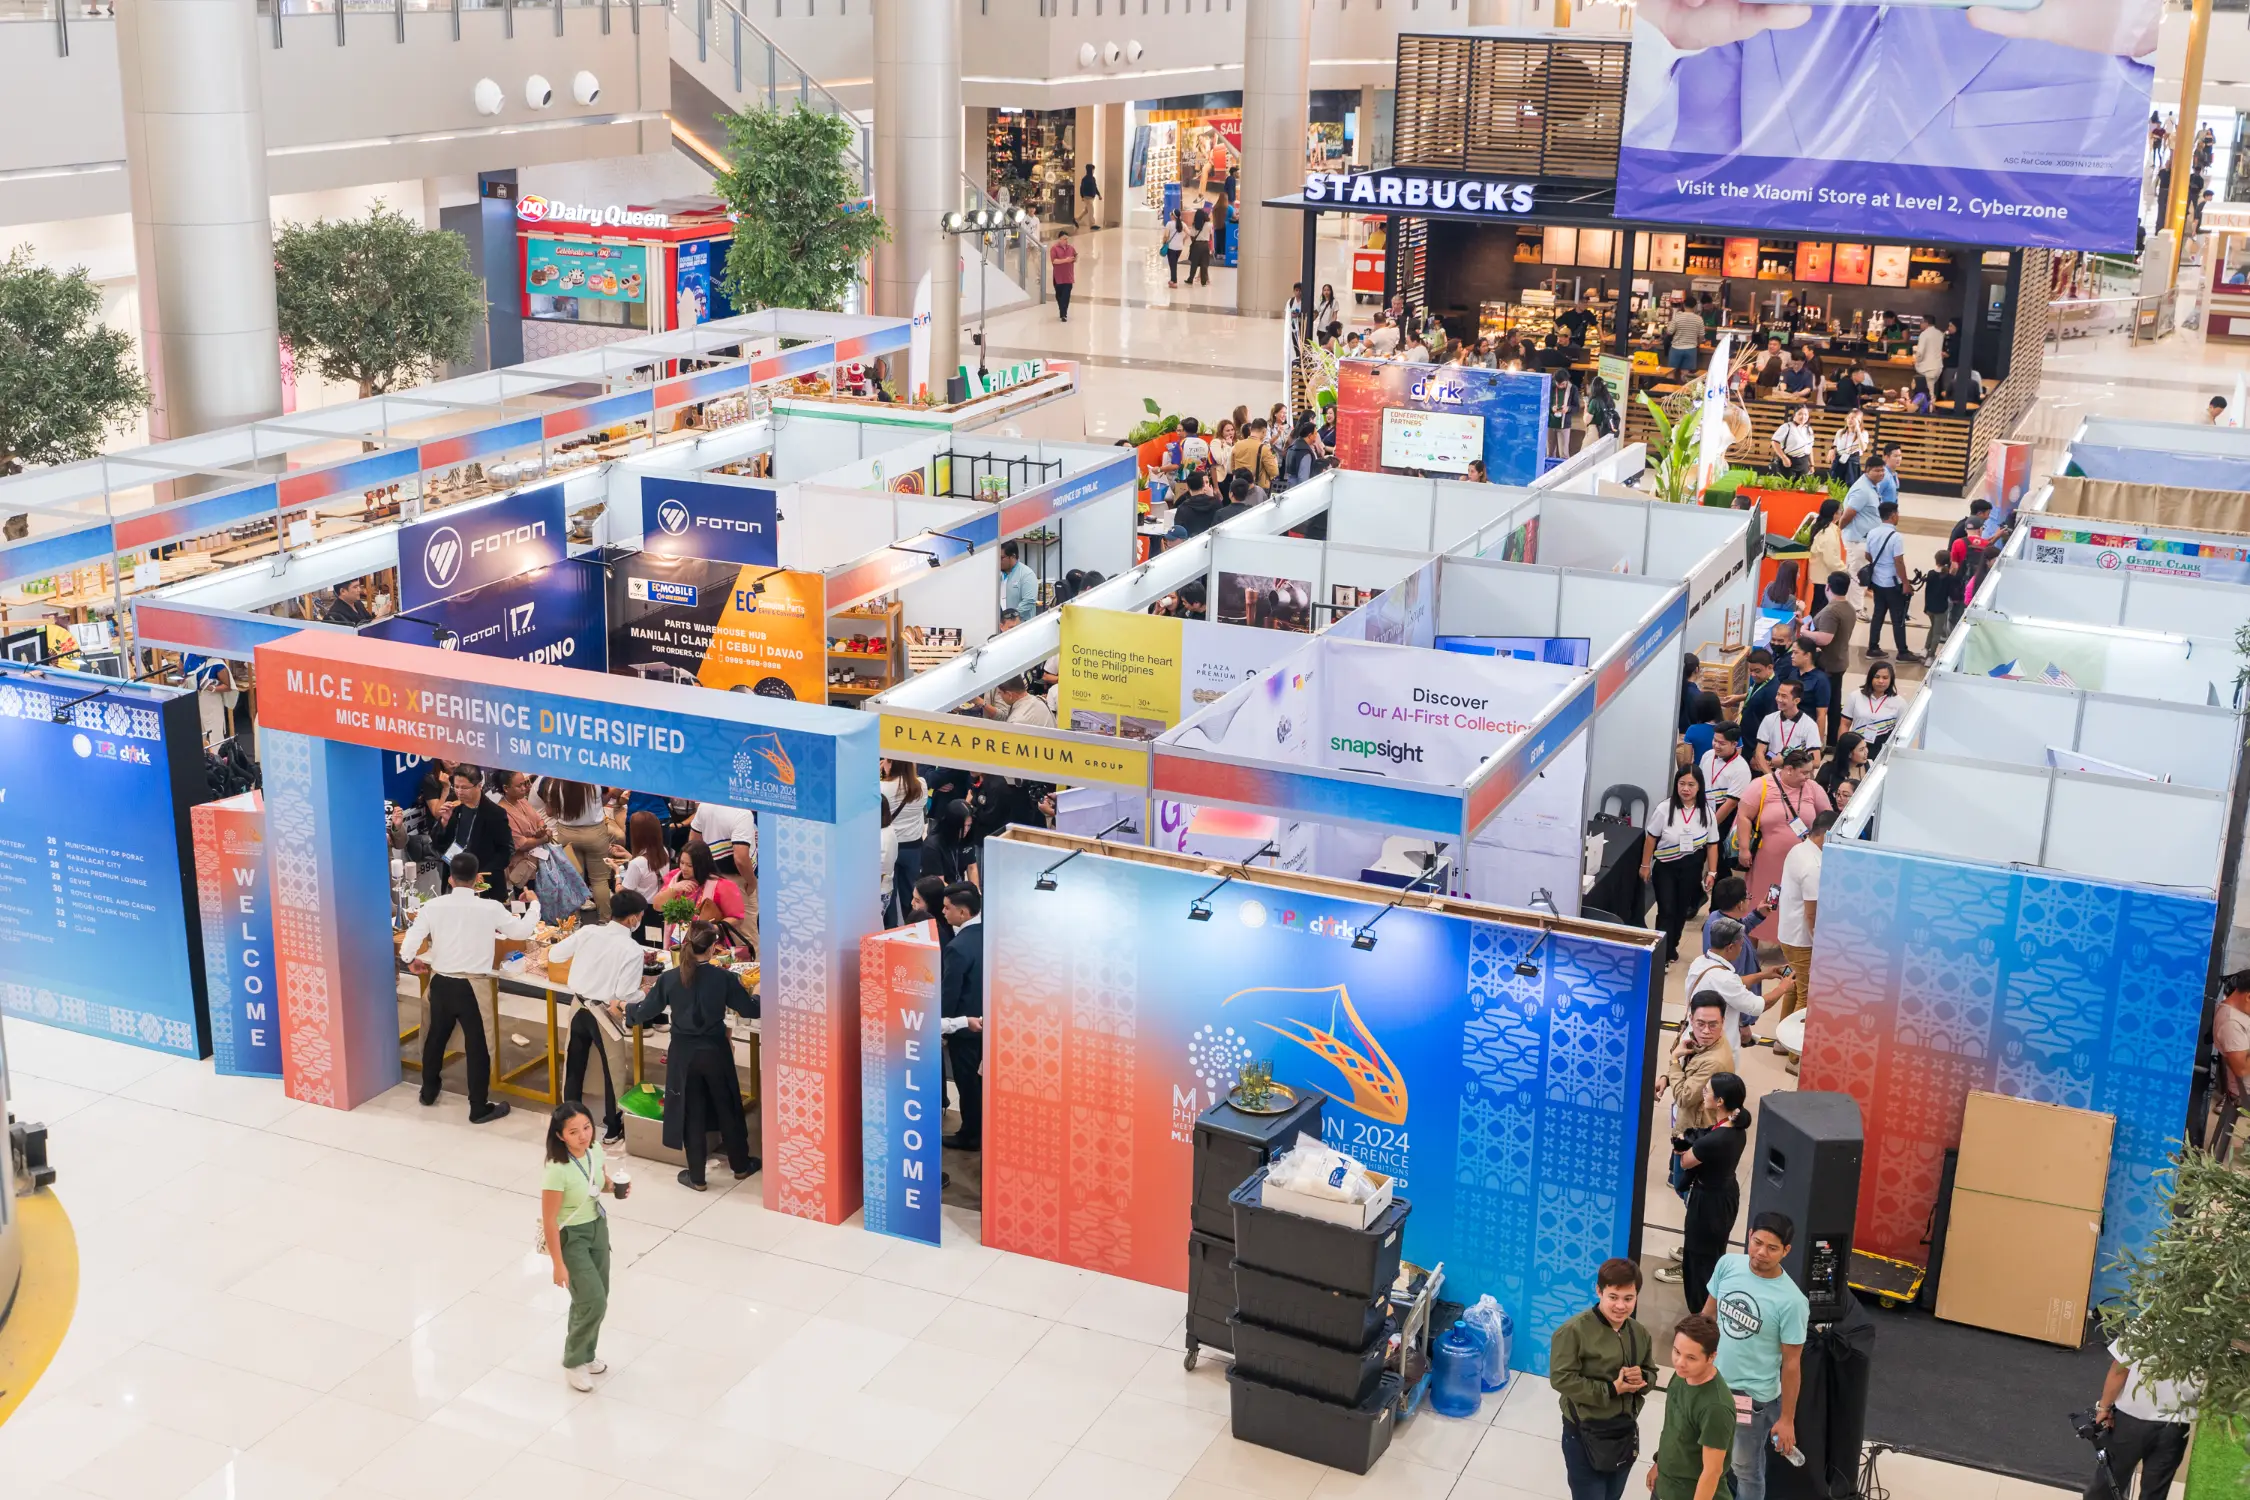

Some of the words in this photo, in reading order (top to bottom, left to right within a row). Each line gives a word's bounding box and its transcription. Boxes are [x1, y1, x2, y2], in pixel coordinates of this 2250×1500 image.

[1305, 172, 1535, 214] STARBUCKS
[1677, 180, 1715, 196] Visit
[1720, 182, 1749, 198] the
[1753, 184, 1813, 202] Xiaomi
[1818, 188, 1867, 205] Store
[1871, 192, 1890, 207] at
[1895, 192, 1942, 212] Level
[1947, 197, 1963, 214] 2,
[1968, 197, 2068, 220] Cyberzone
[522, 205, 543, 217] DQ
[549, 201, 603, 227] Dairy
[605, 205, 670, 228] Queen
[1391, 412, 1429, 421] CONFERENCE
[1391, 419, 1422, 427] PARTNERS
[696, 516, 762, 534] FOTON
[471, 520, 546, 558] FOTON
[651, 583, 693, 597] ECMOBILE
[736, 590, 757, 613] EC
[787, 604, 805, 614] Parts
[463, 624, 501, 646] FOTON
[510, 602, 535, 632] 17
[513, 625, 536, 637] YEARS
[664, 619, 692, 630] PARTS
[693, 623, 746, 638] WAREHOUSE
[748, 631, 767, 641] HUB
[630, 627, 671, 642] MANILA
[680, 634, 716, 649] CLARK
[726, 641, 757, 654] CEBU
[766, 647, 804, 660] DAVAO
[652, 645, 665, 653] FOR
[666, 648, 694, 658] ORDERS,
[1072, 645, 1127, 662] Connecting
[1129, 652, 1145, 662] the
[1147, 655, 1173, 667] heart
[1072, 657, 1082, 667] of
[1083, 658, 1099, 668] the
[1101, 660, 1154, 676] Philippines
[1072, 668, 1082, 678] to
[1083, 670, 1099, 680] the
[1101, 673, 1127, 684] world
[1196, 670, 1236, 680] PREMIUM
[1203, 663, 1230, 672] PLAZA
[1413, 688, 1489, 710] Discover
[287, 669, 353, 701] M.I.C.E
[362, 681, 398, 707] XD:
[406, 688, 531, 731] XPERIENCE
[540, 709, 685, 754] DIVERSIFIED
[1358, 701, 1387, 719] Our
[1391, 707, 1450, 726] AI-First
[95, 740, 117, 756] TPB
[336, 708, 370, 728] MICE
[376, 715, 486, 749] MARKETPLACE
[510, 737, 531, 756] SM
[537, 742, 571, 762] CITY
[578, 748, 632, 772] CLARK
[894, 725, 962, 748] PLAZA
[972, 736, 1073, 764] PREMIUM
[1085, 759, 1124, 771] GROUP
[1331, 736, 1424, 763] snapsight
[780, 785, 796, 796] 2024
[48, 848, 57, 857] 27
[66, 853, 104, 866] MABALACAT
[107, 861, 121, 869] CITY
[65, 841, 109, 855] MUNICIPALITY
[122, 852, 144, 862] PORAC
[68, 865, 88, 875] PLAZA
[91, 870, 118, 881] PREMIUM
[121, 876, 147, 887] LOUNGE
[53, 884, 62, 893] 30
[71, 889, 91, 899] ROYCE
[93, 895, 113, 904] HOTEL
[116, 899, 129, 907] AND
[132, 901, 156, 912] CASINO
[56, 896, 64, 905] 31
[97, 906, 117, 916] CLARK
[120, 911, 140, 921] HOTEL
[232, 867, 266, 1047] WELCOME
[900, 1008, 924, 1209] WELCOME
[1353, 1122, 1410, 1154] 2024
[1720, 1300, 1760, 1332] BAGUIO
